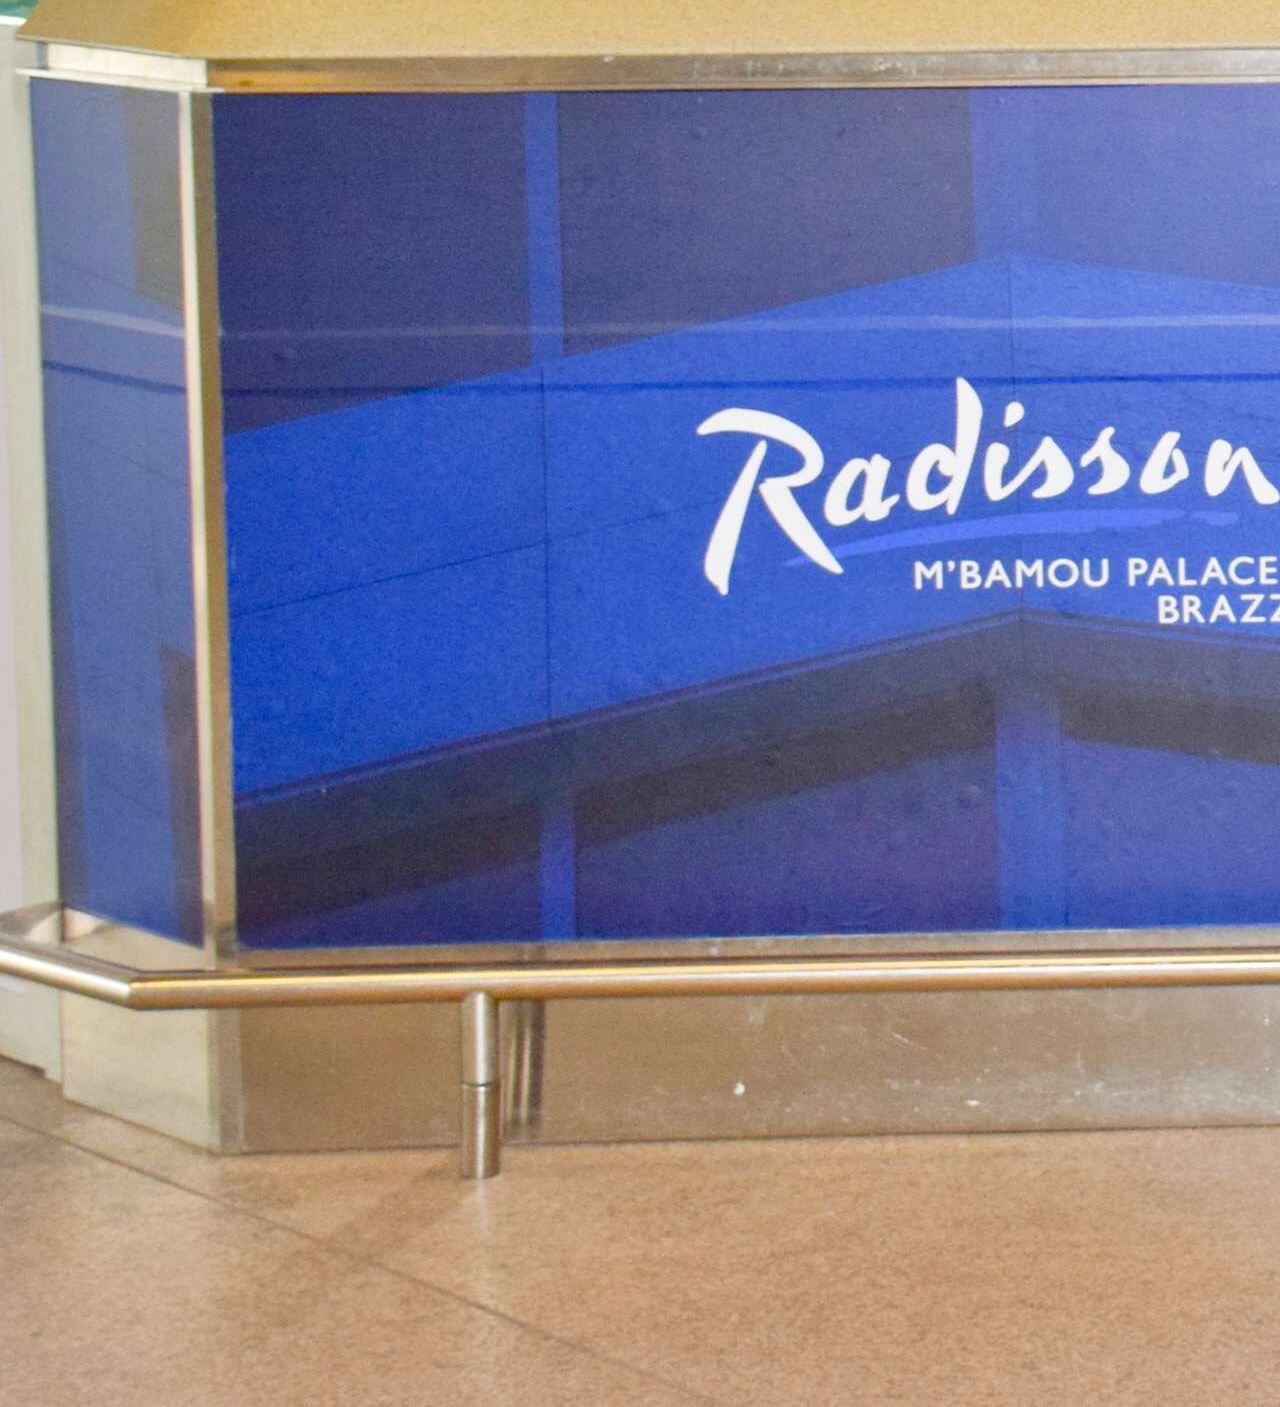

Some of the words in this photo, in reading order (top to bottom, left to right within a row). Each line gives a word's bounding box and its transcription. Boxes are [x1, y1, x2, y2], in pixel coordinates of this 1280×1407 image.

[697, 377, 1280, 595] Radisson
[915, 558, 1109, 590] M'BAMOU
[1128, 556, 1278, 586] PALACE
